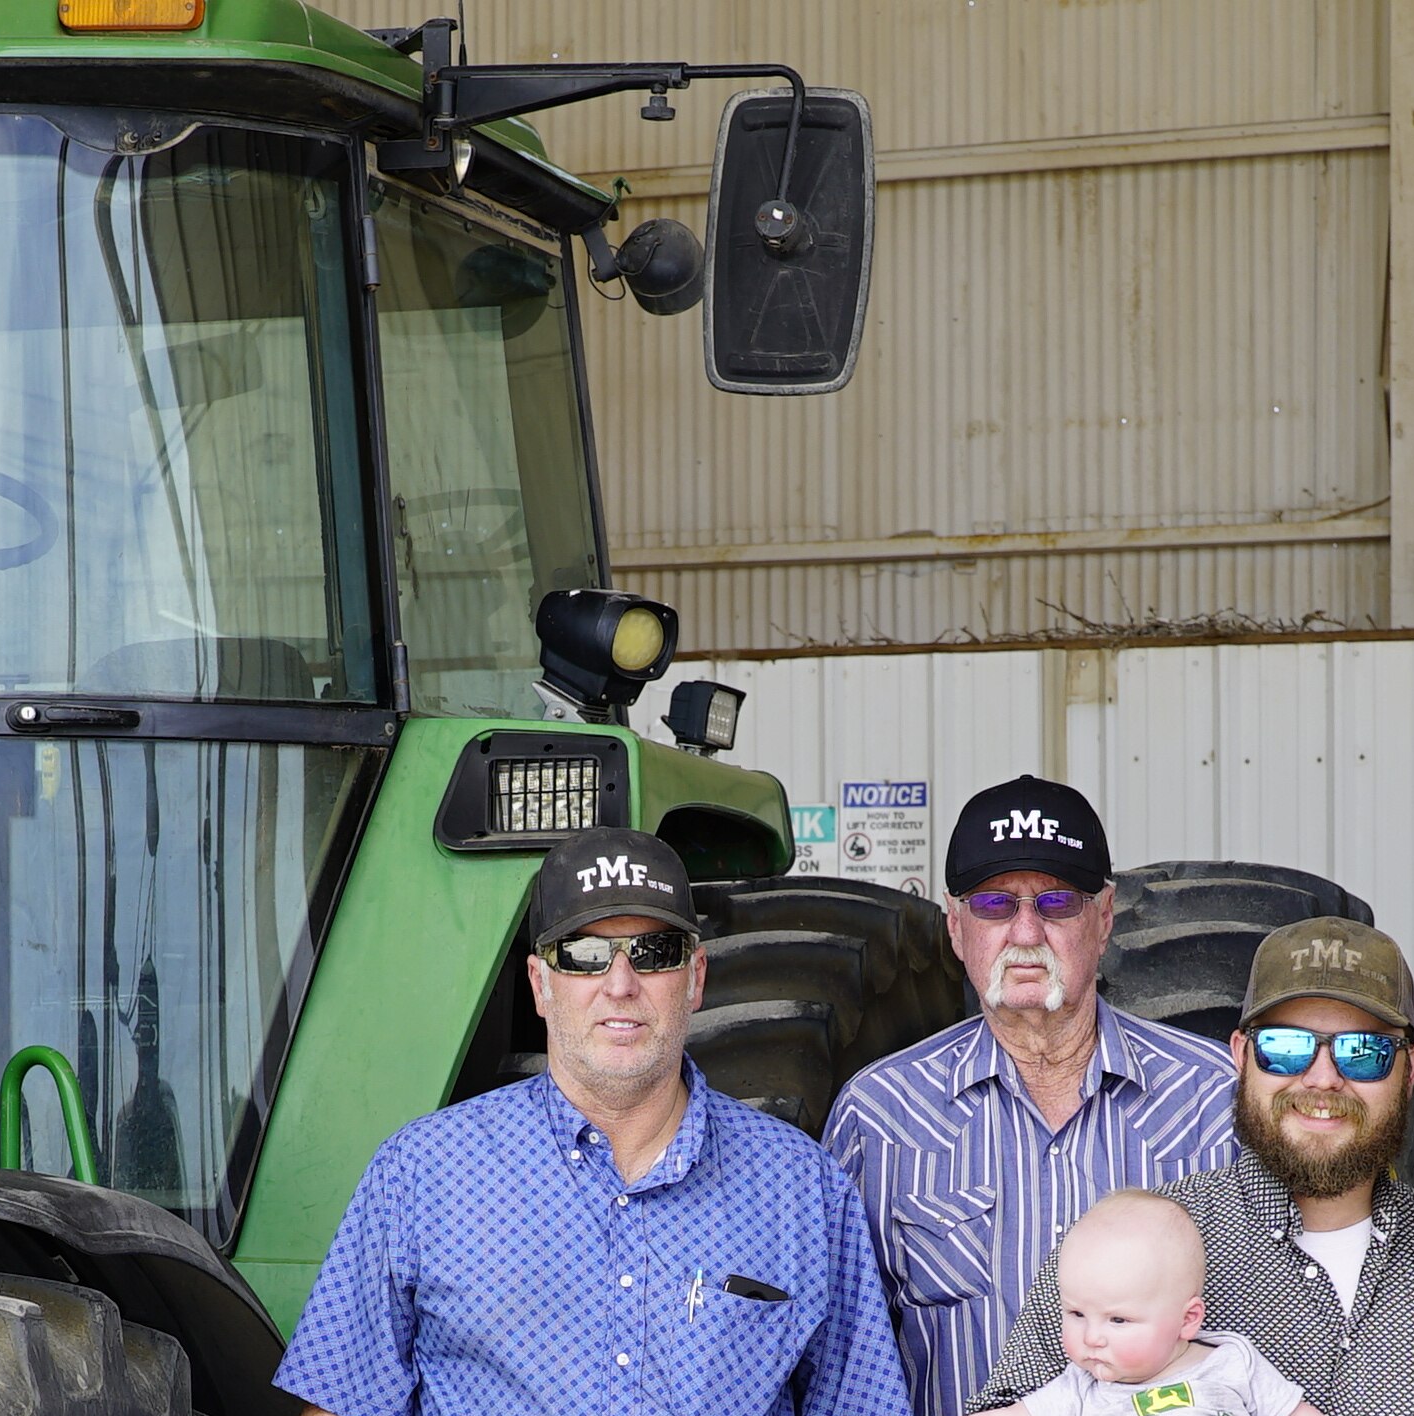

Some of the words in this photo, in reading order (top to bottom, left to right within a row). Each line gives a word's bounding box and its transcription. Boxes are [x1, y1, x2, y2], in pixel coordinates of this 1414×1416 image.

[845, 785, 925, 806] NOTICE
[846, 822, 867, 831] LIFT
[870, 822, 924, 830] CORRECTLY
[866, 812, 890, 820] HOW
[893, 812, 906, 820] TO
[990, 809, 1059, 842] TMF
[576, 855, 648, 893] TMF
[798, 860, 820, 872] ON
[1290, 938, 1363, 972] TMF
